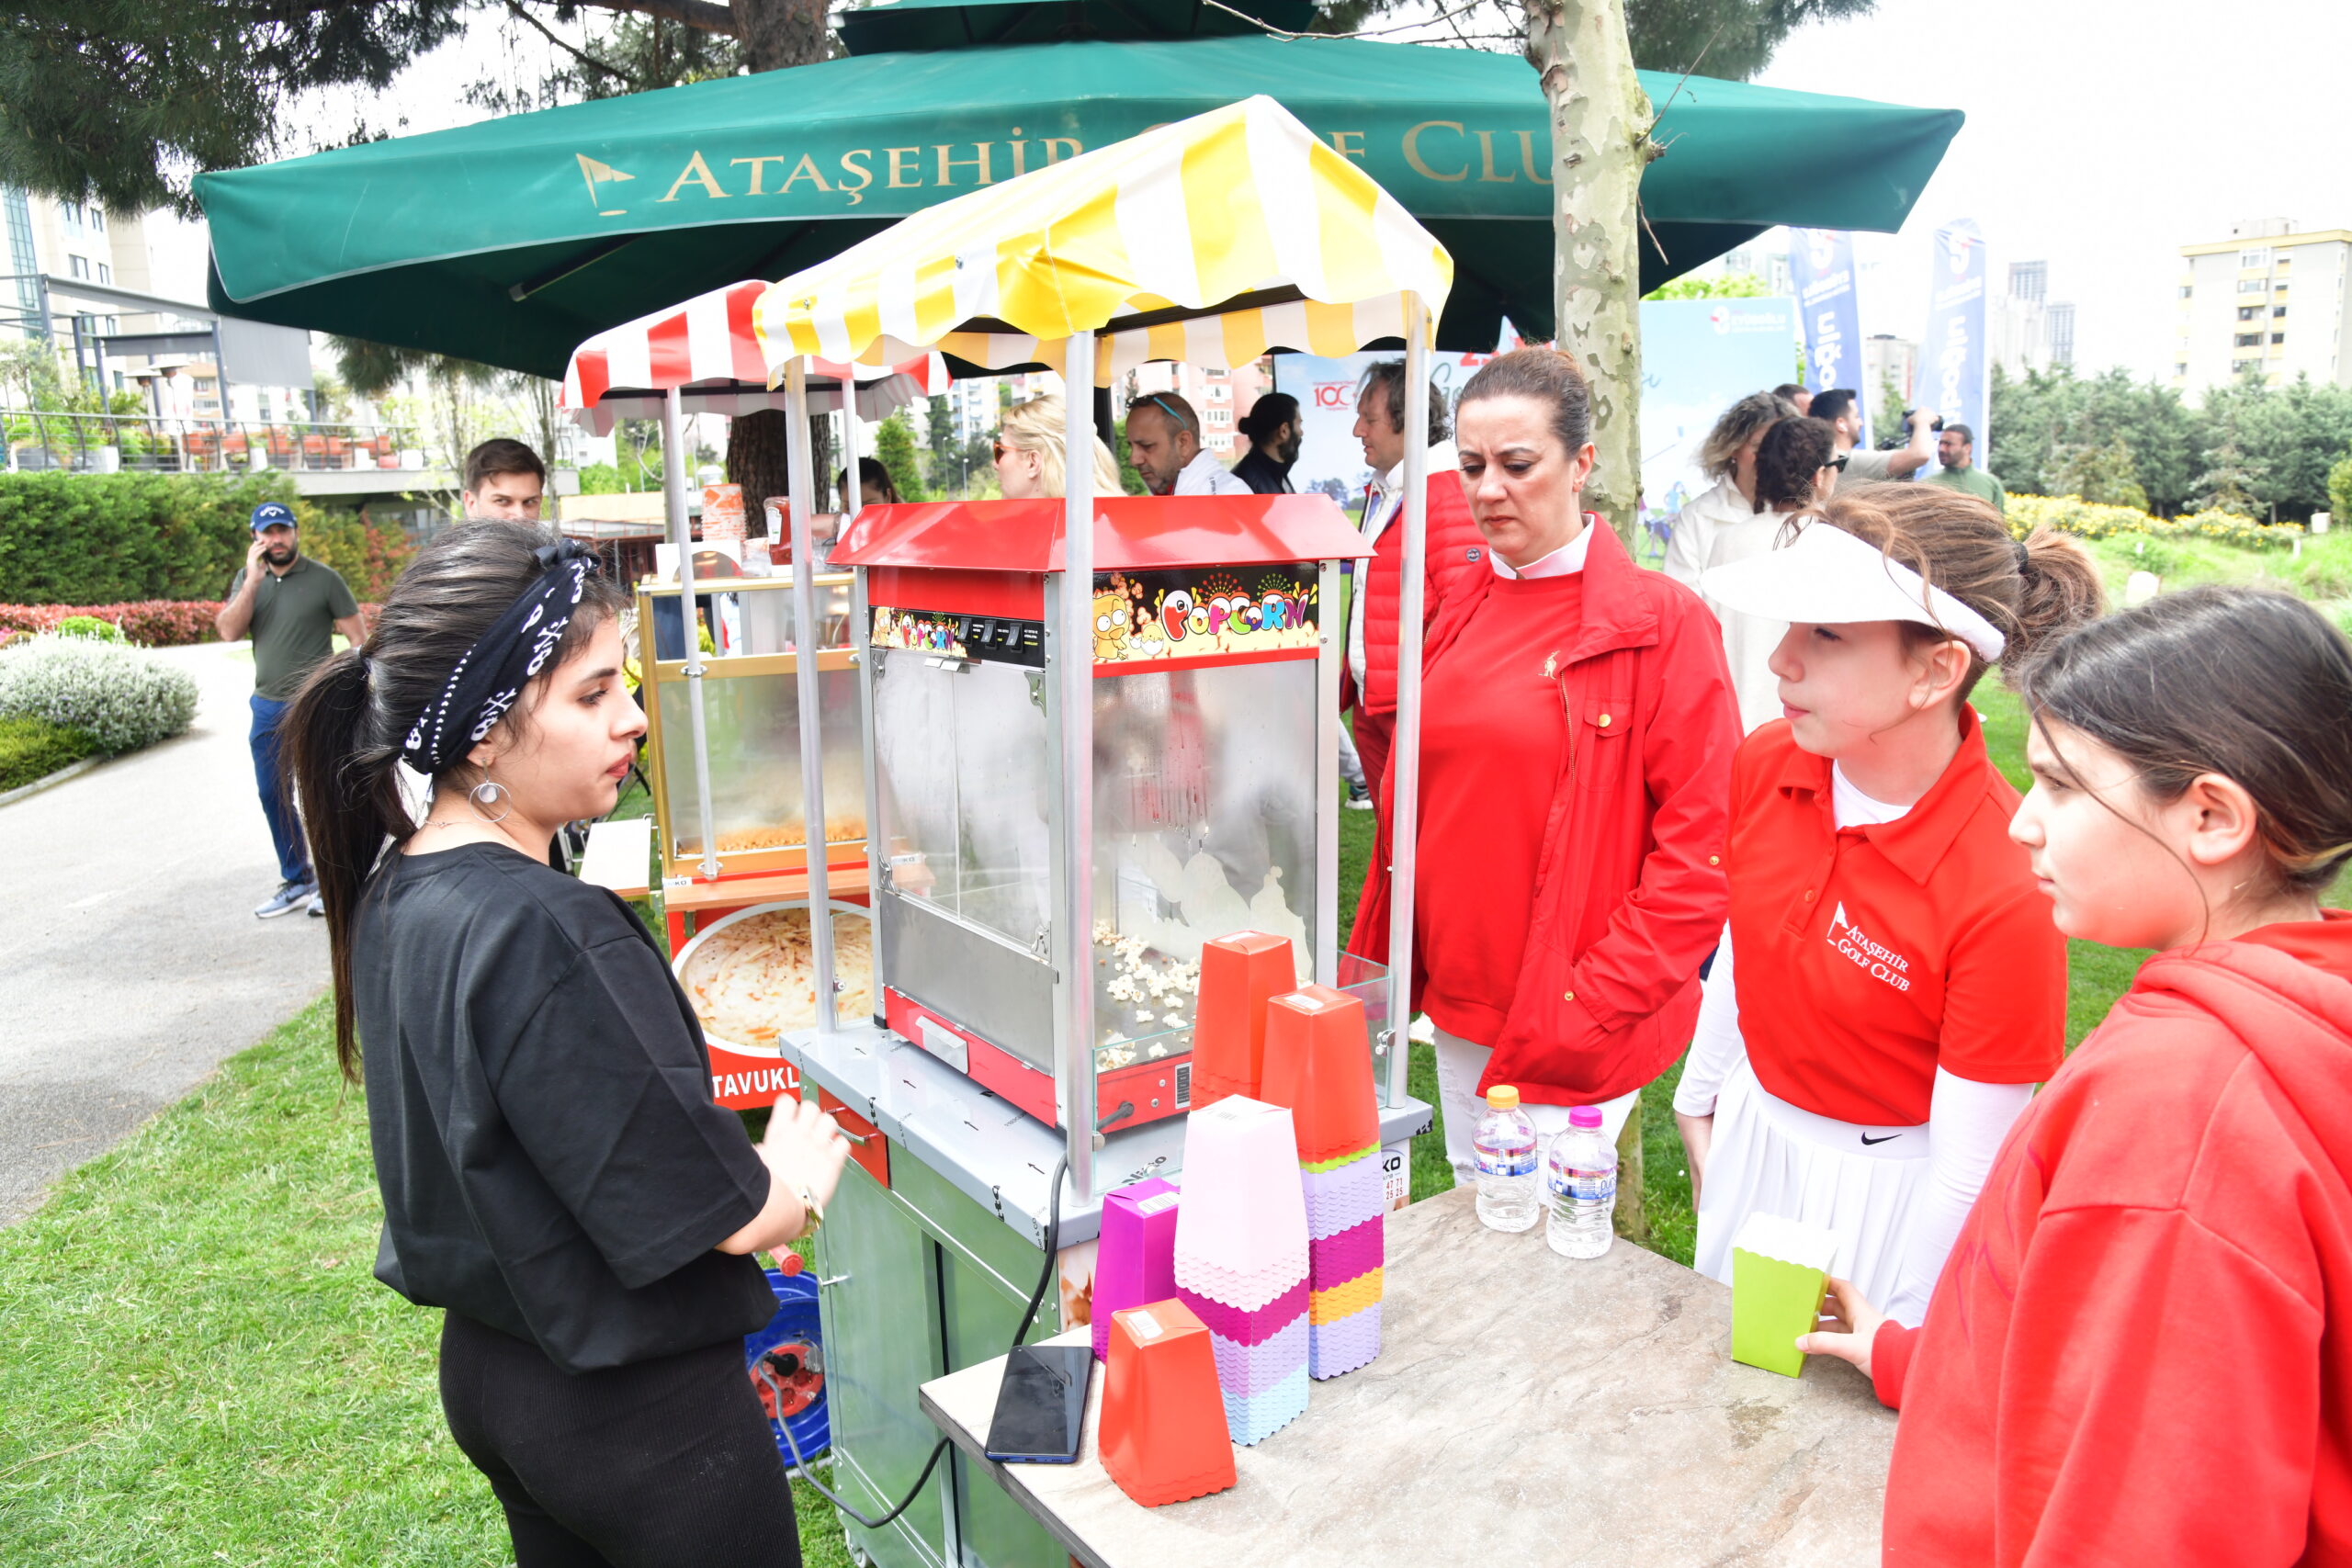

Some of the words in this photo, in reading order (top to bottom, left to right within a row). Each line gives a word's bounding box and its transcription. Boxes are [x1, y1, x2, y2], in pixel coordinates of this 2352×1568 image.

[1401, 120, 1555, 185] CLU
[1838, 939, 1871, 968] GOLF
[1871, 963, 1910, 991] CLUB
[1846, 925, 1908, 973] ATAŞEHİR
[713, 1066, 800, 1098] TAVUKL
